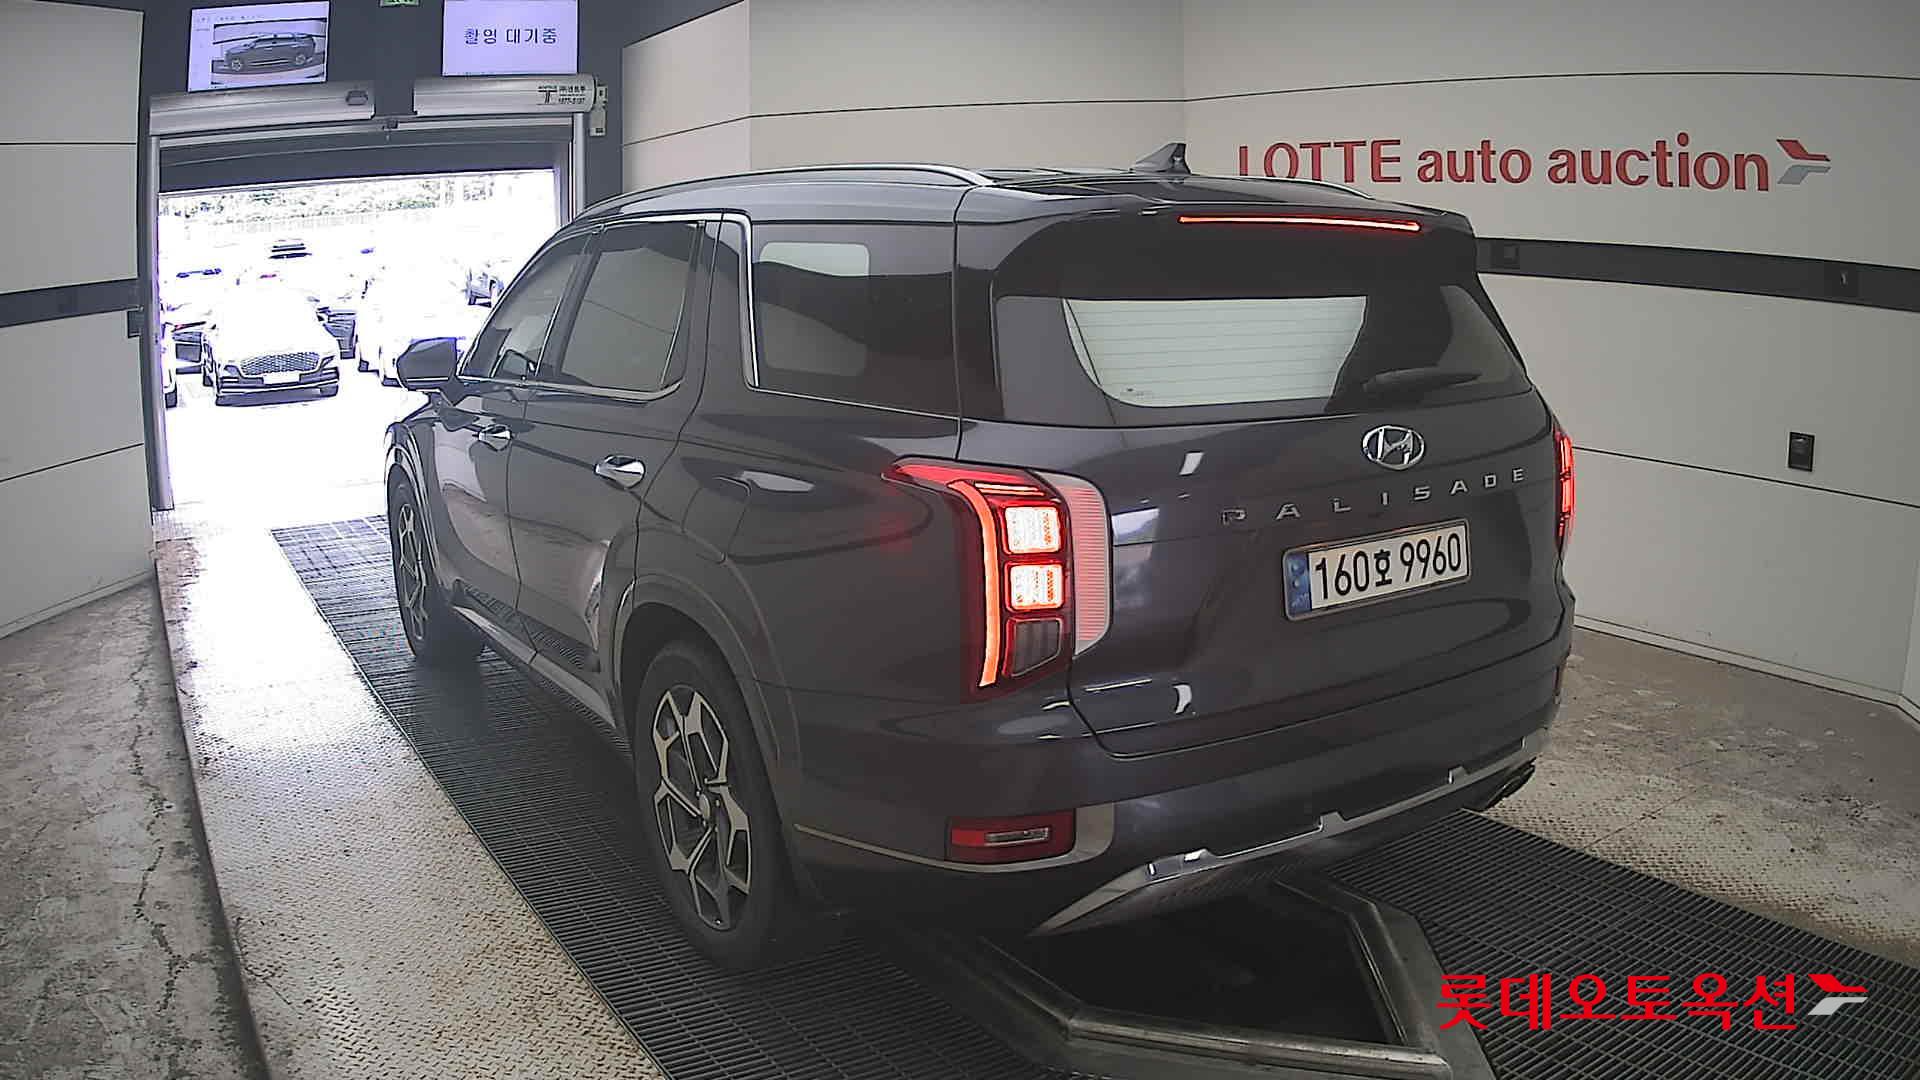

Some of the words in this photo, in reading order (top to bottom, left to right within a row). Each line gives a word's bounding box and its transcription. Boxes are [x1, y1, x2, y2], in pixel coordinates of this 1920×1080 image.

[505, 27, 557, 45] 대기중
[1416, 140, 1532, 184] auto
[1547, 132, 1769, 191] auction
[1221, 468, 1526, 525] PALISADE
[1315, 549, 1393, 600] 160호
[1399, 532, 1463, 583] 9960
